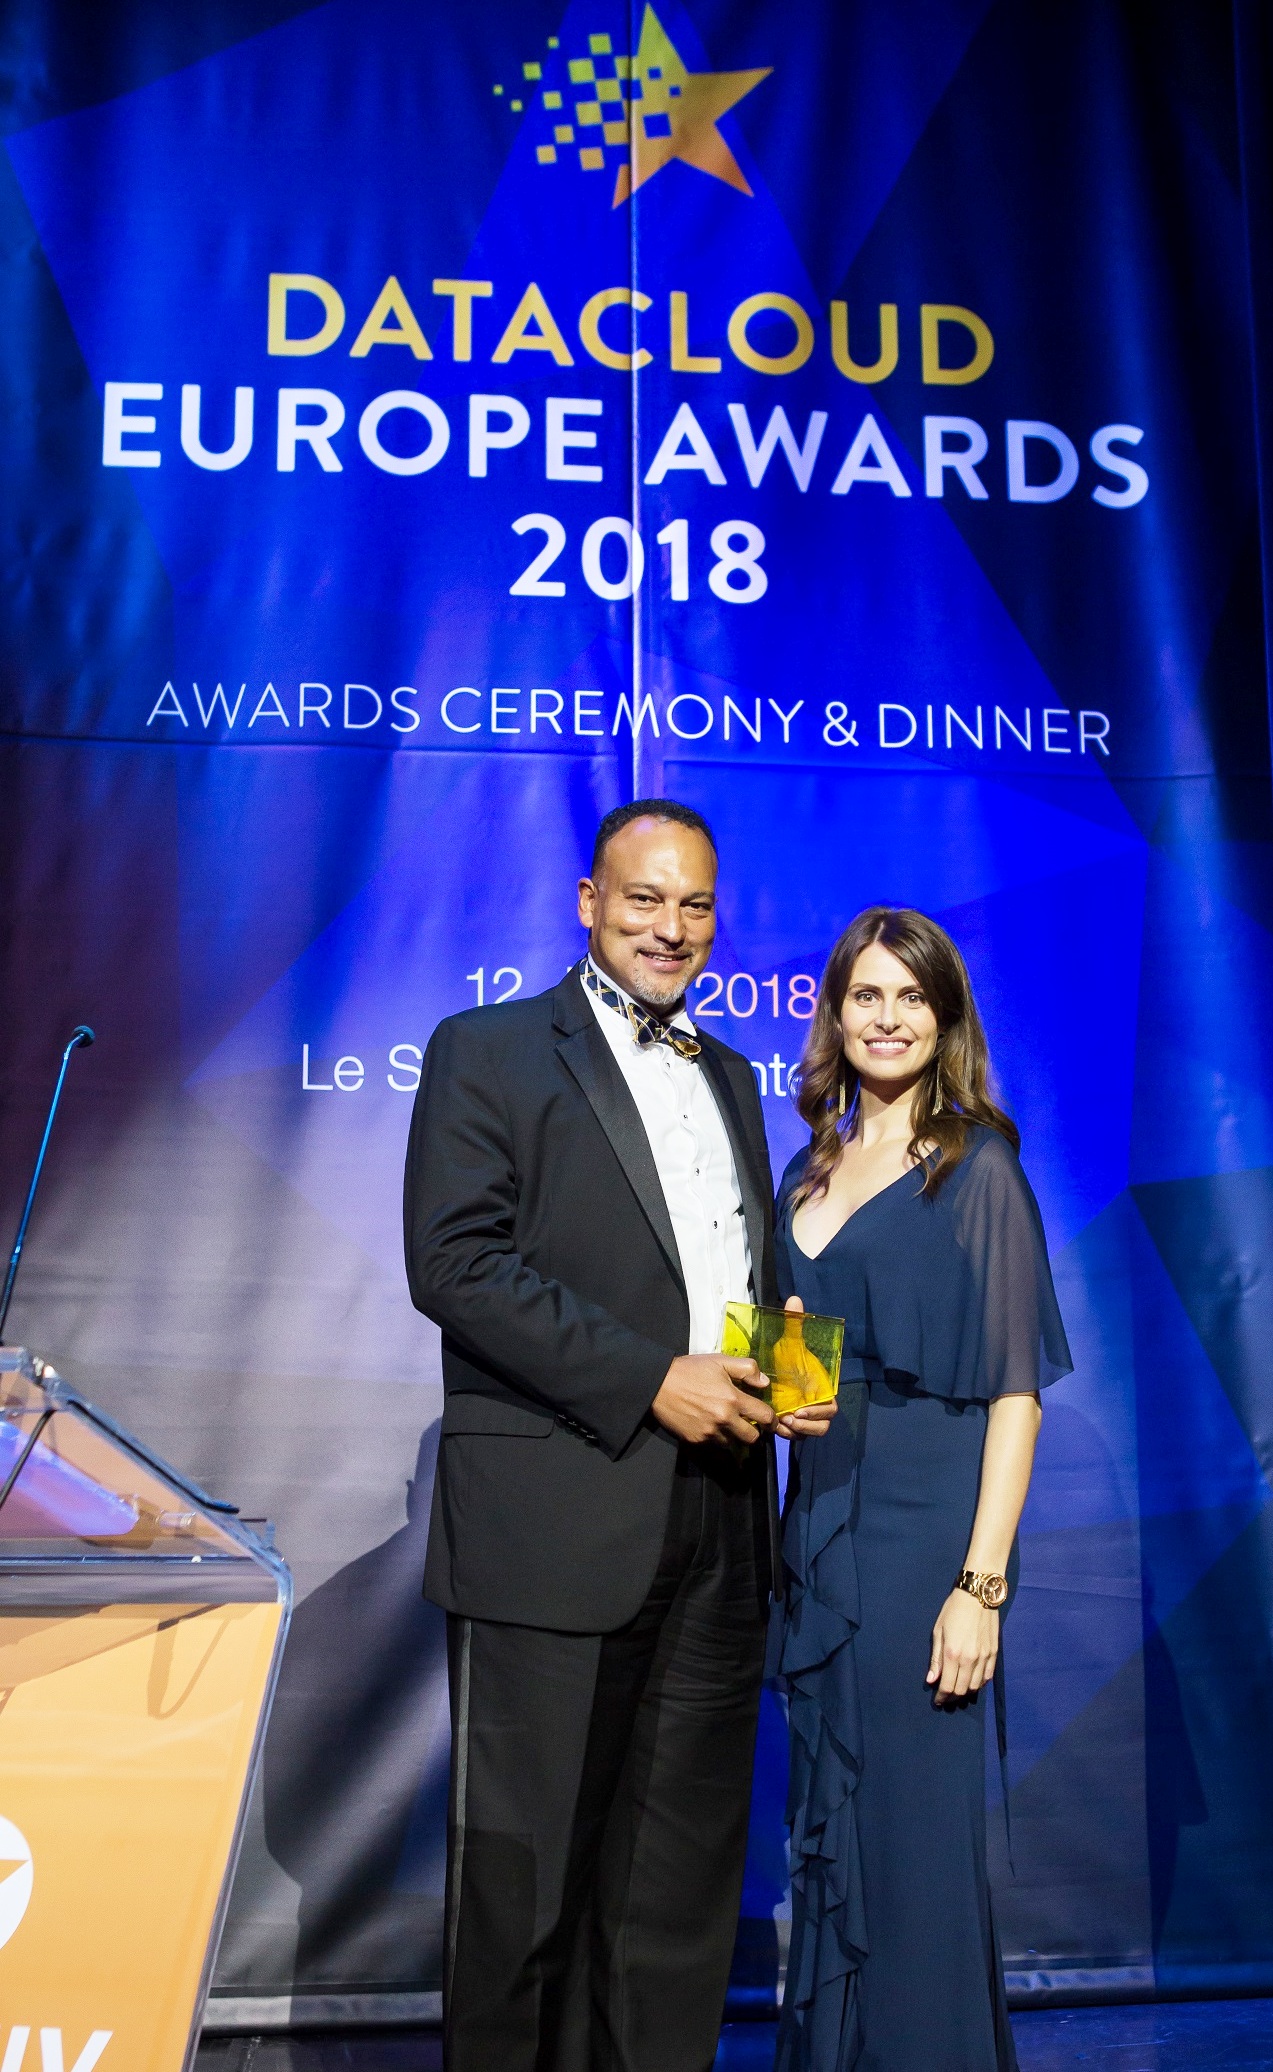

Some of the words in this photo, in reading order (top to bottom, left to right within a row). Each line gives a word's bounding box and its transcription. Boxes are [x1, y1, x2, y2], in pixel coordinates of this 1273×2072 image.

[267, 273, 995, 386] DATACLOUD
[102, 382, 604, 482] EUROPE
[645, 402, 1150, 509] AWARDS
[508, 513, 769, 603] 2018
[146, 681, 421, 733] AWARDS
[440, 687, 804, 743] CEREMONY
[823, 701, 860, 747] &
[879, 703, 1111, 755] DINNER
[466, 967, 522, 1006] 12
[694, 972, 817, 1019] 2018
[302, 1043, 365, 1092] Le
